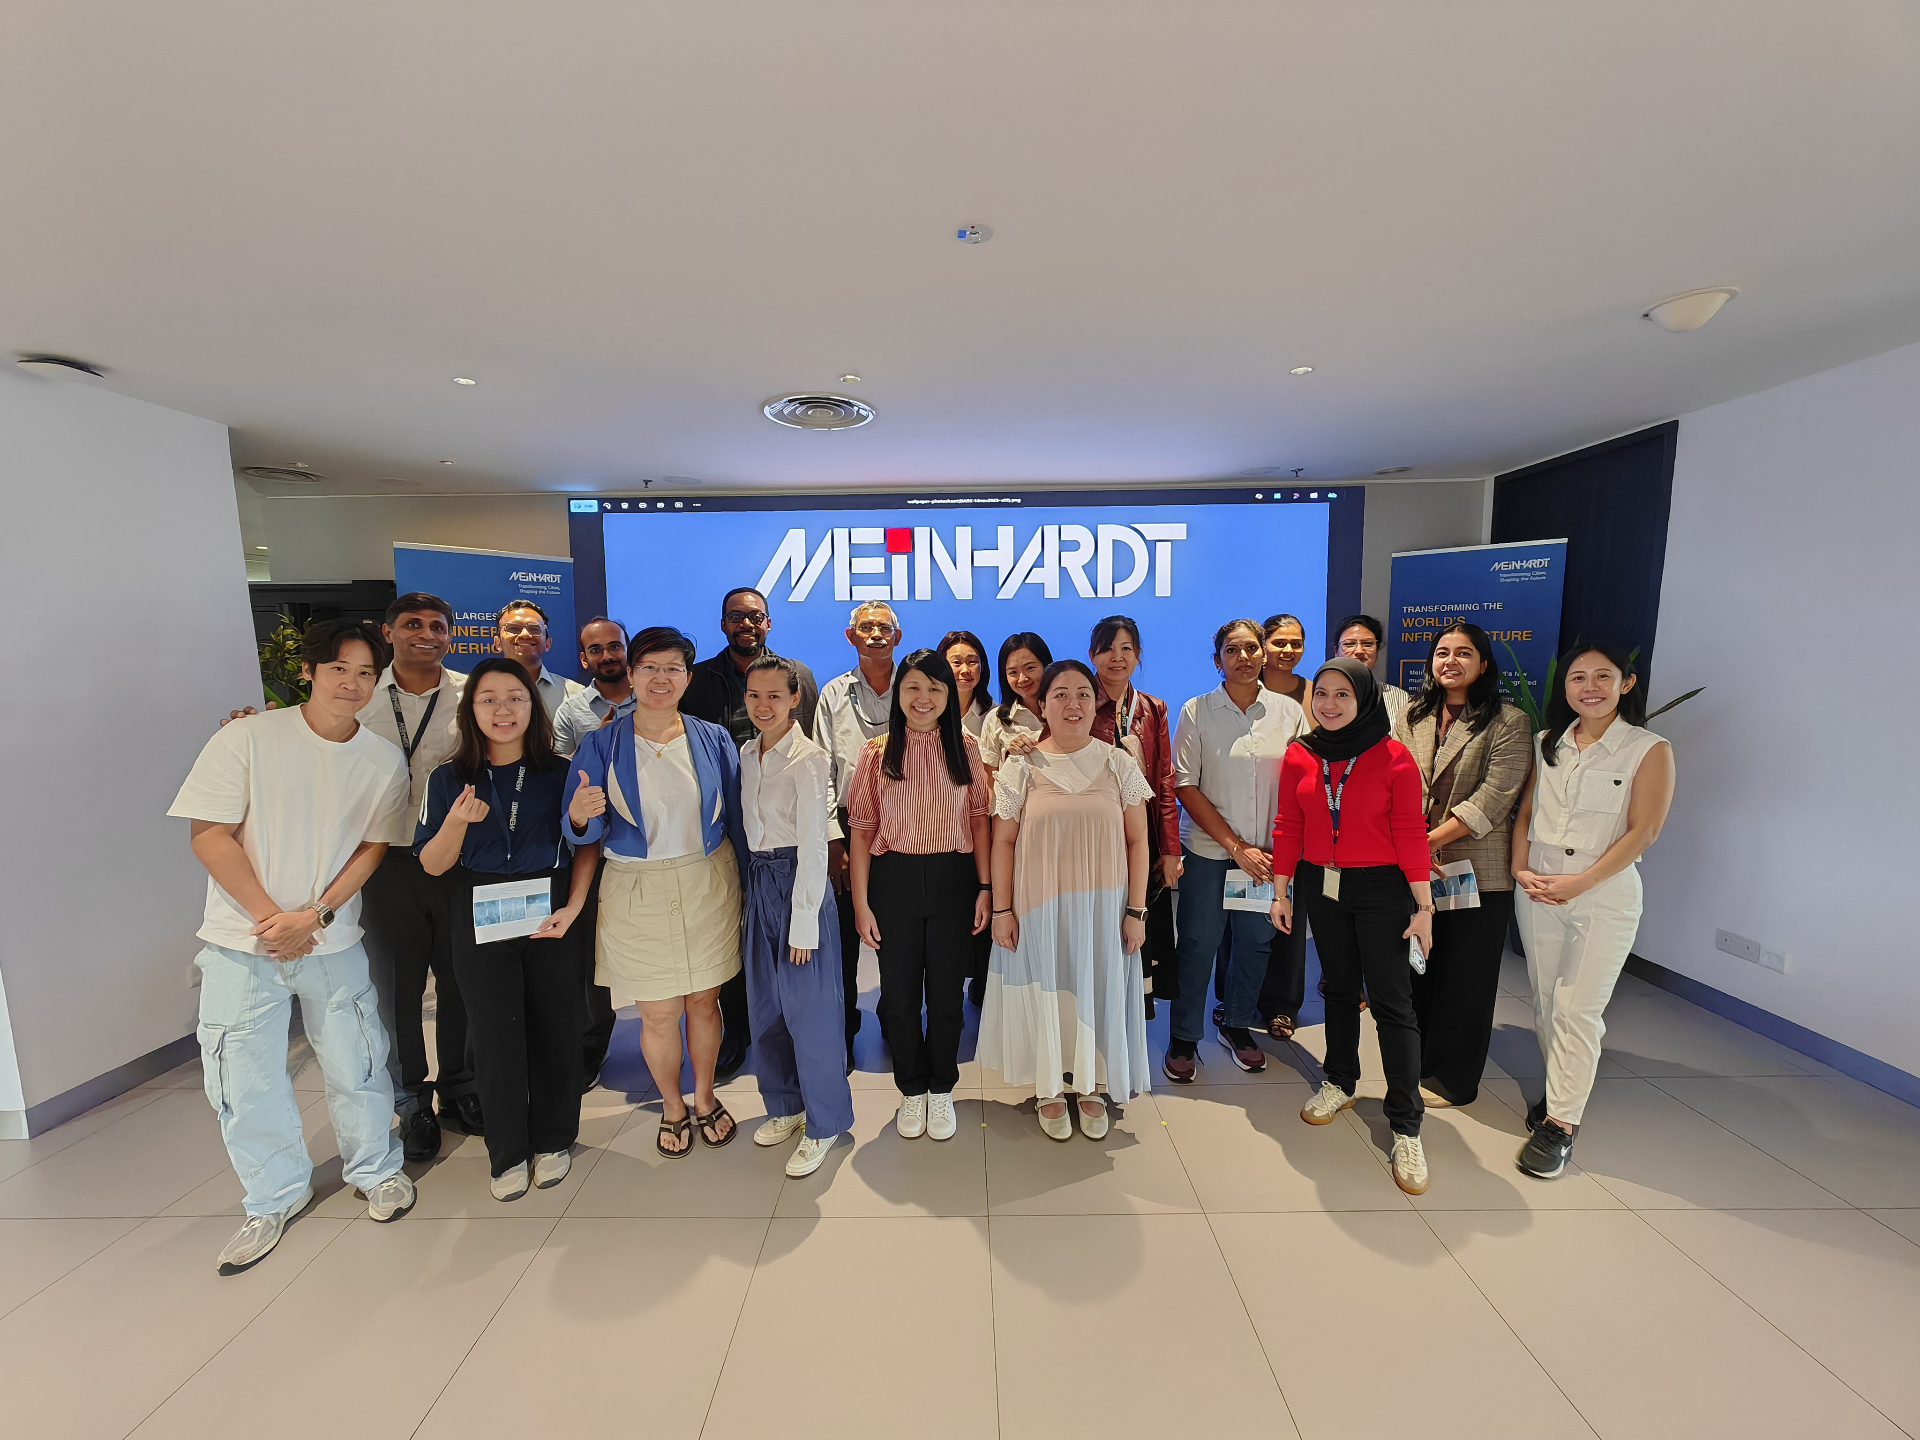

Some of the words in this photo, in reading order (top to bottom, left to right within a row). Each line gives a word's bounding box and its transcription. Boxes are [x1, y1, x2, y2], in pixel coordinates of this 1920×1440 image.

[1402, 603, 1480, 613] TRANSFORMING
[1482, 602, 1503, 610] THE
[455, 611, 499, 621] LARGES
[1401, 630, 1533, 643] INFRTURE
